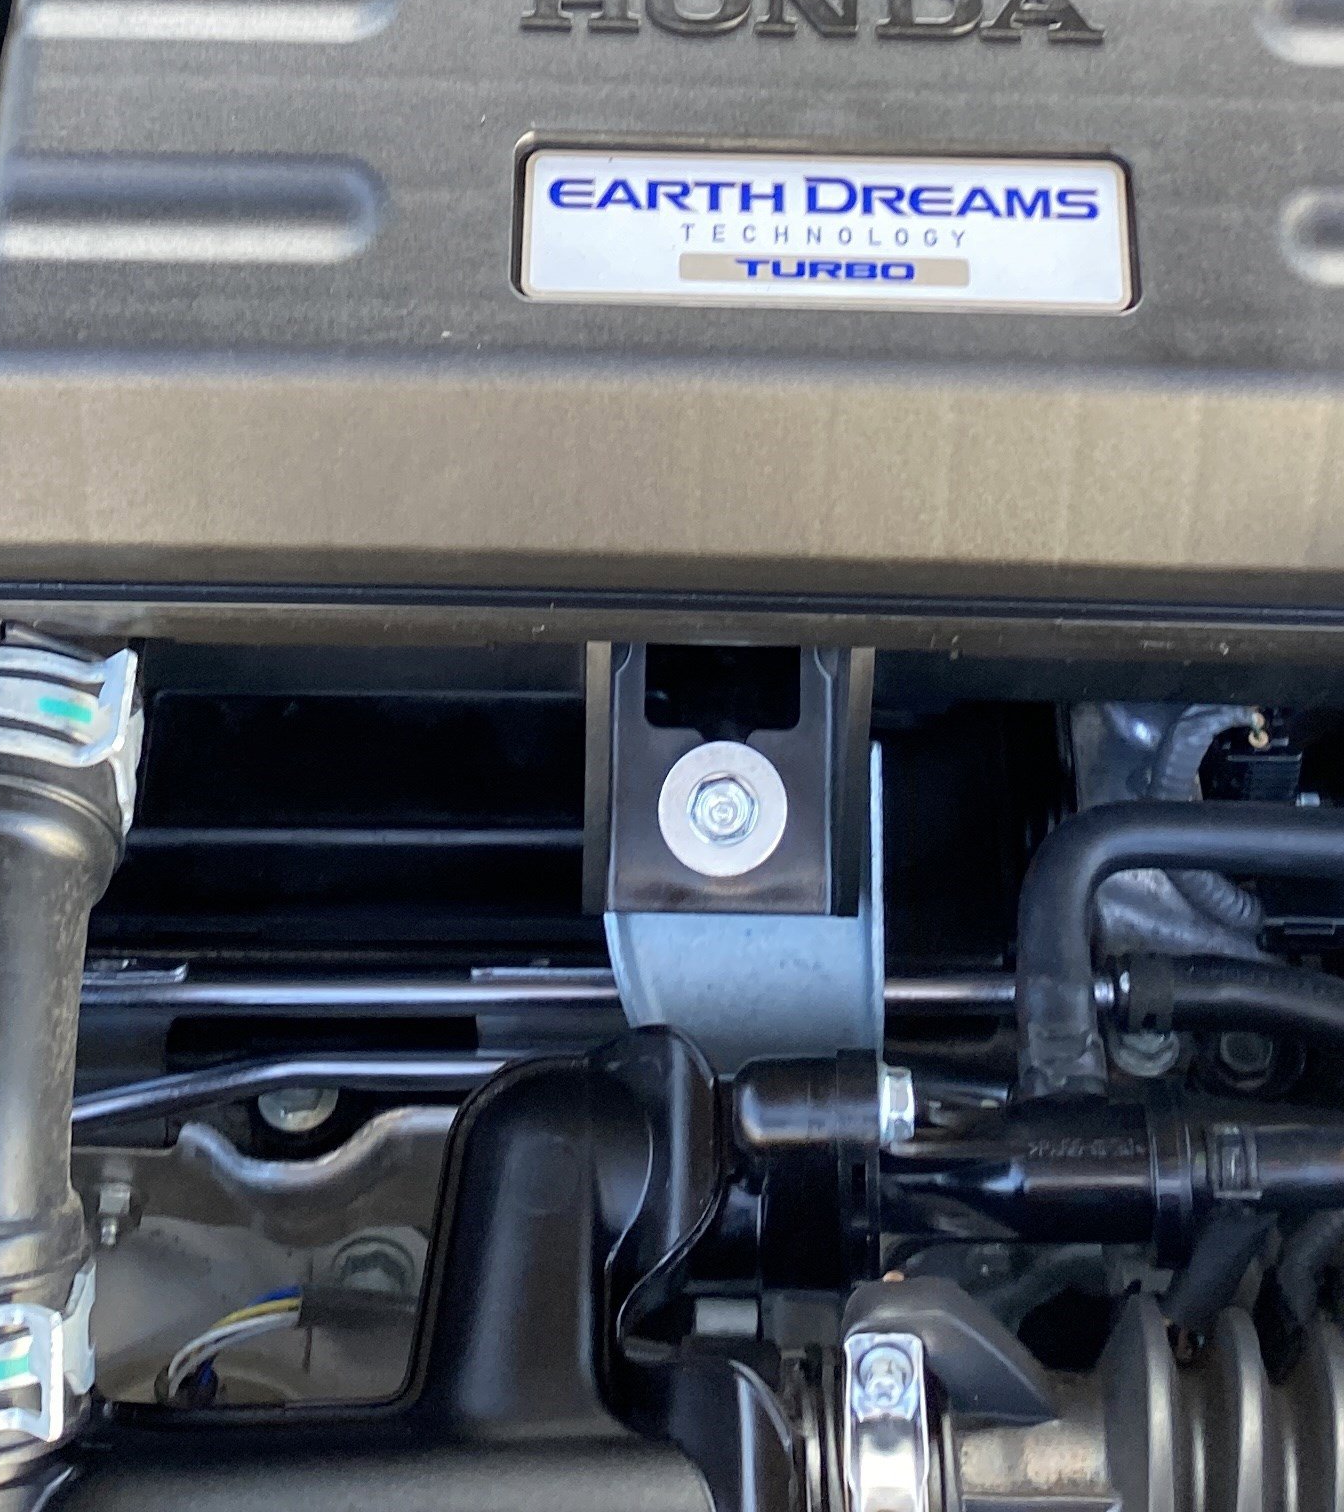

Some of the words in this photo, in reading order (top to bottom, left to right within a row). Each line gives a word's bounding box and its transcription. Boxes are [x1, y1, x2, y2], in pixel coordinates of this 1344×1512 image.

[549, 178, 785, 214] EARTH
[804, 176, 1099, 220] DREAMS
[681, 223, 967, 248] TECHNOLOGY
[737, 259, 916, 281] TURBO
